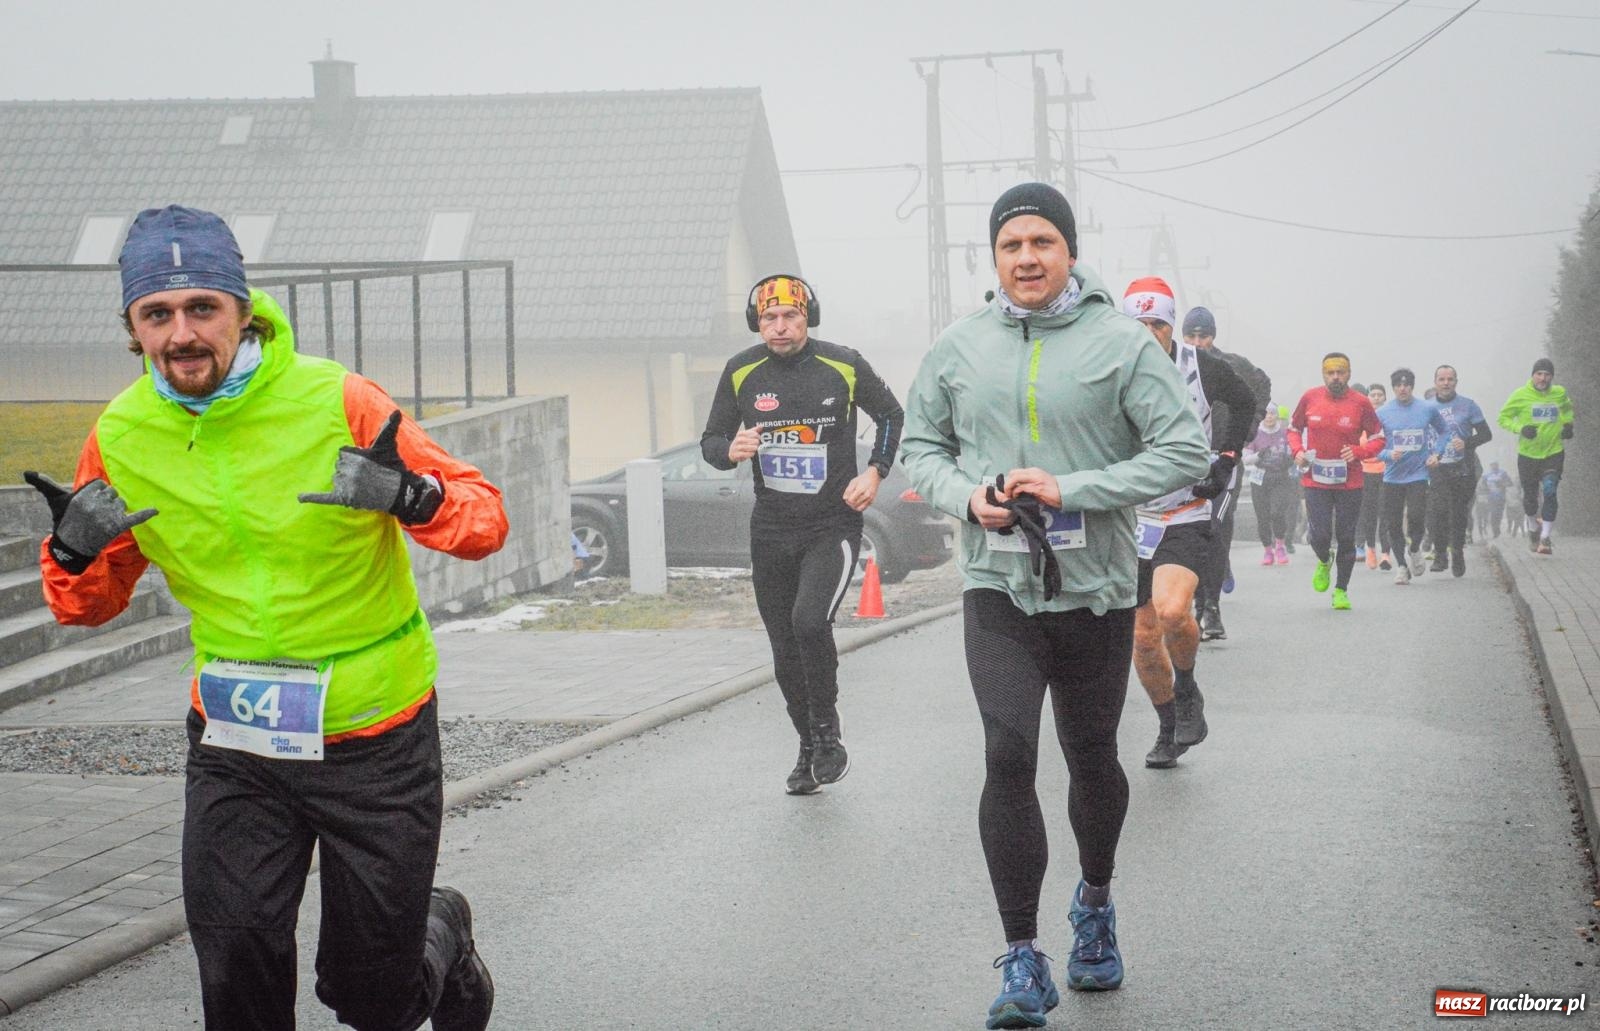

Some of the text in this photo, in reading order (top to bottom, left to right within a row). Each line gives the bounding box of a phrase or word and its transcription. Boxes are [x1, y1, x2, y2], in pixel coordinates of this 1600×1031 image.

[822, 397, 836, 406] 4F
[802, 416, 837, 425] SOLARNA
[771, 456, 815, 479] 151
[231, 682, 282, 728] 64
